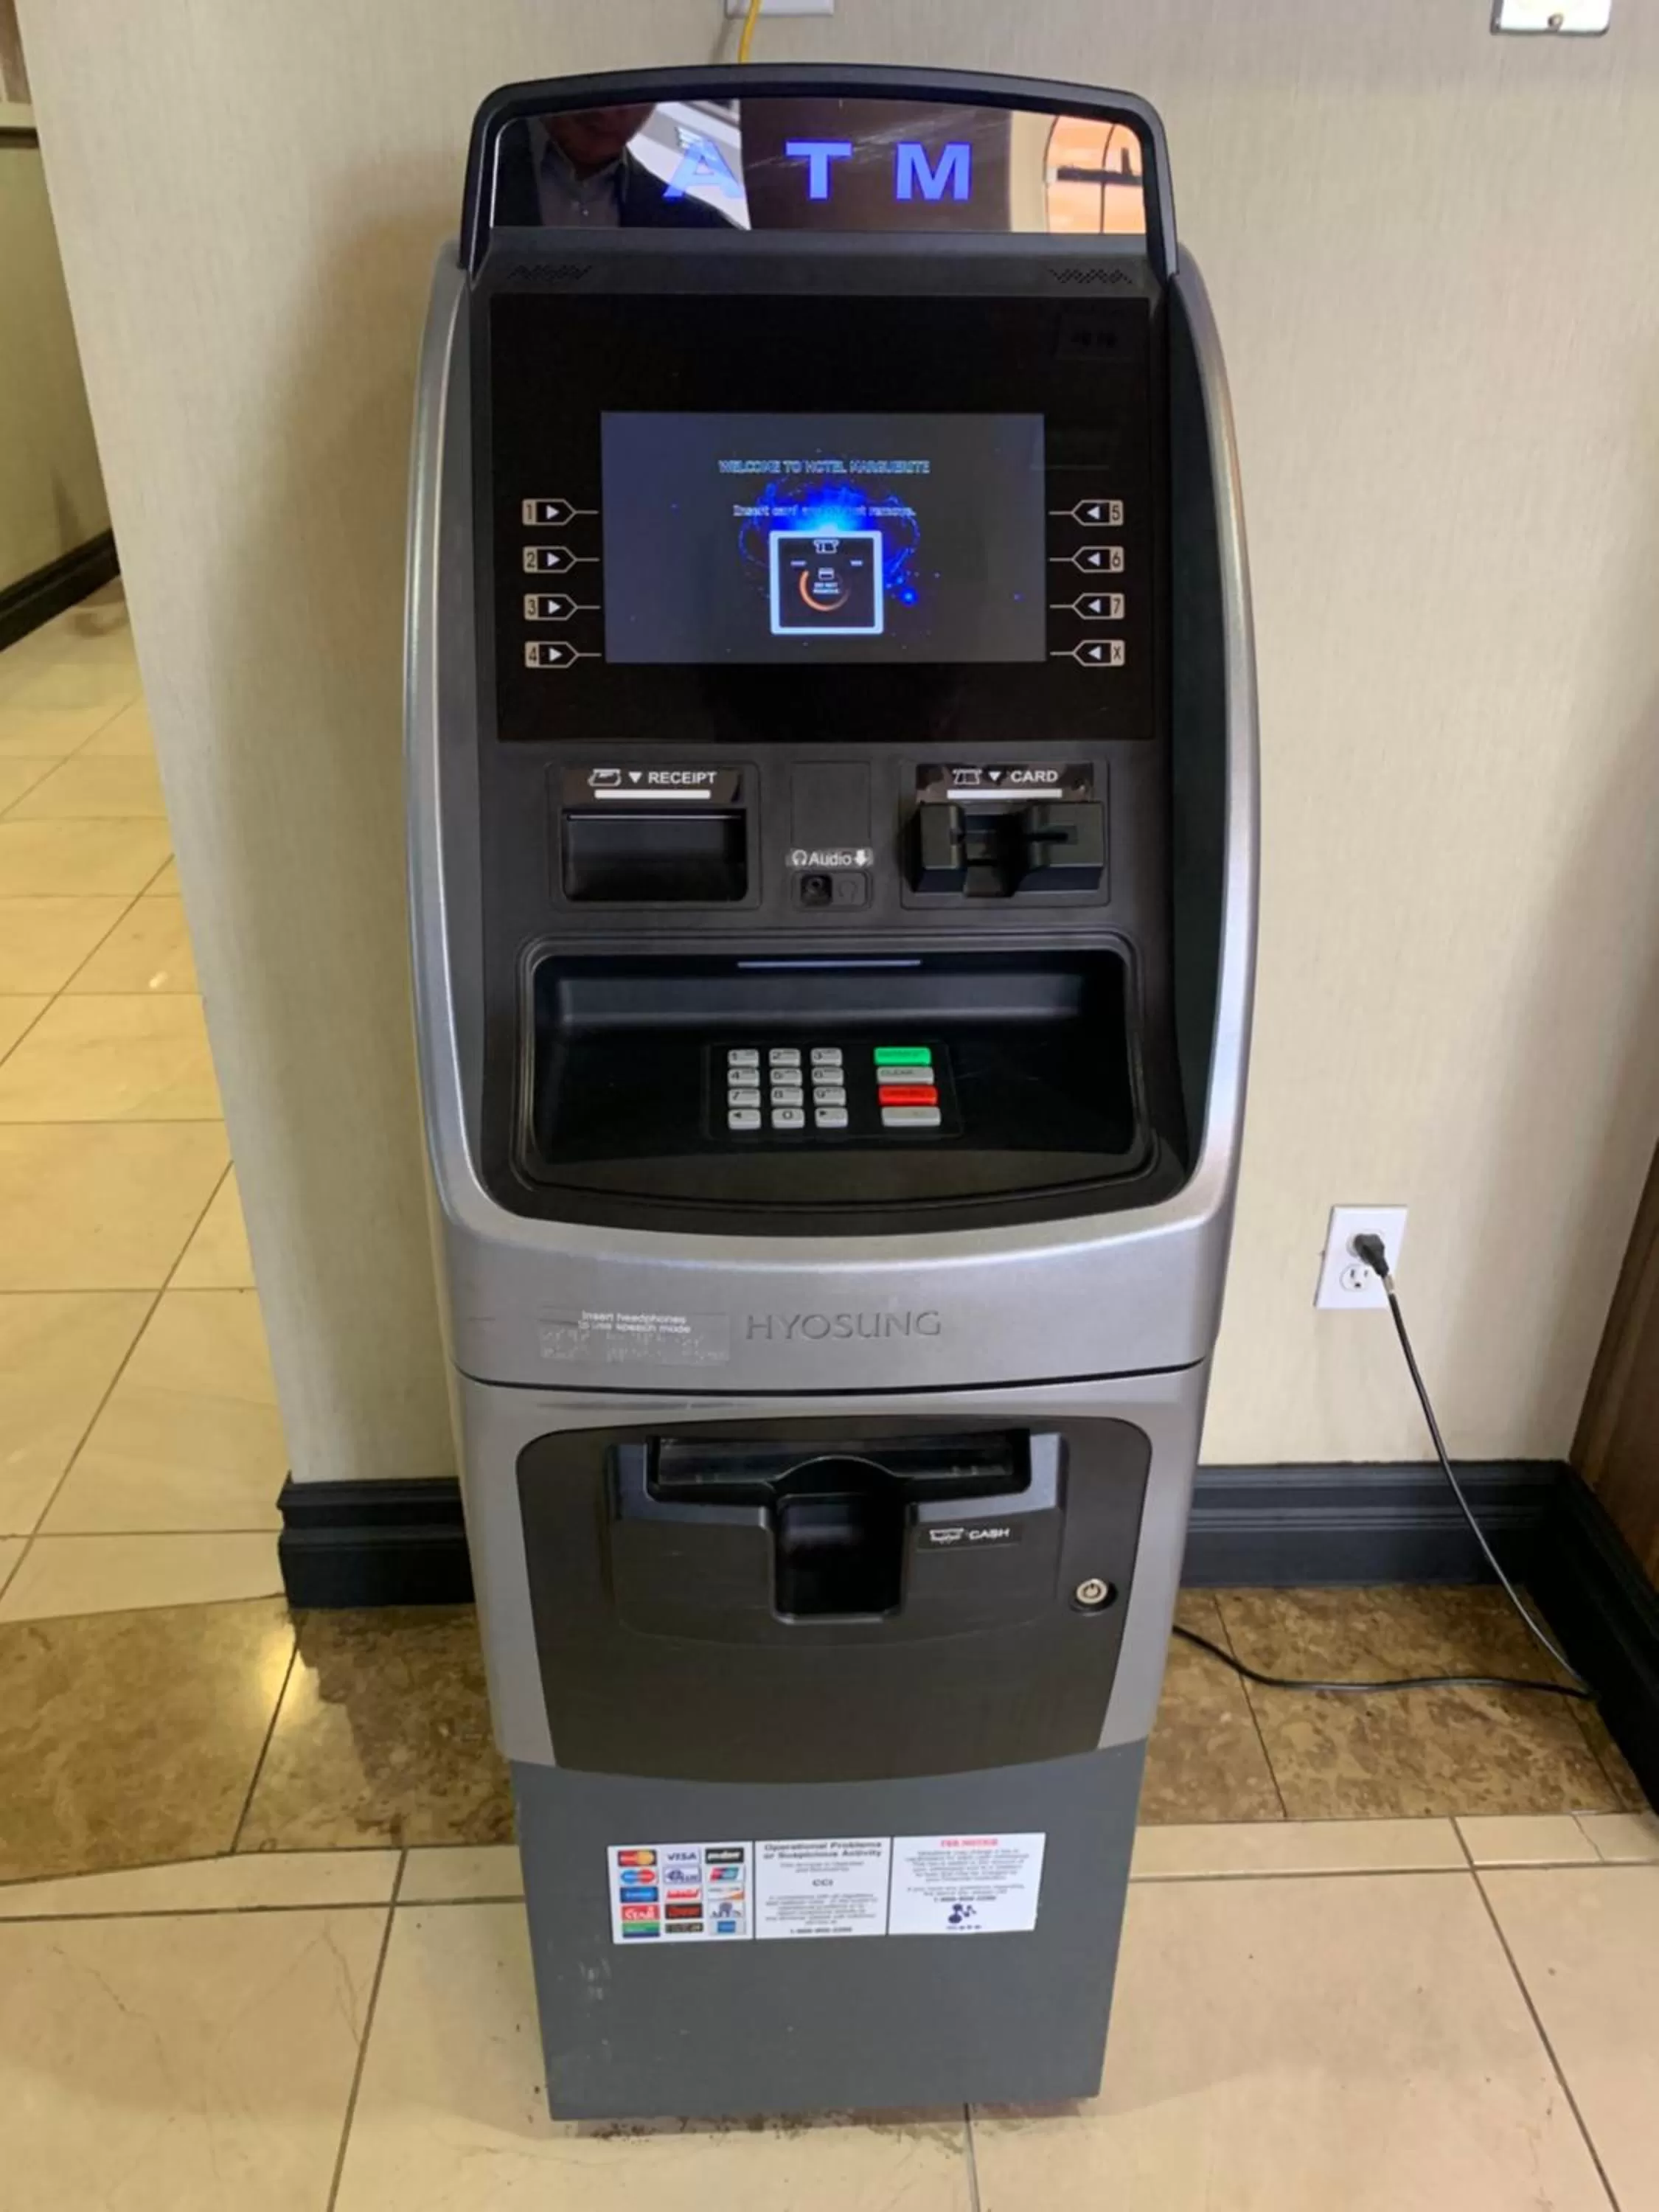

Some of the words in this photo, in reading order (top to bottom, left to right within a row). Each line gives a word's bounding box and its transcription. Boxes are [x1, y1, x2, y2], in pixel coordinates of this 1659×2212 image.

[718, 460, 781, 473] WELCOME
[782, 460, 802, 473] TO
[804, 460, 846, 473] HOTEL
[647, 771, 717, 784] RECEIPT
[1010, 770, 1059, 782] CARD
[808, 851, 852, 866] Audio
[616, 1312, 686, 1325] headphones
[745, 1310, 942, 1340] HYOSUNG
[969, 1527, 1011, 1540] CASH
[667, 1852, 697, 1862] VISA
